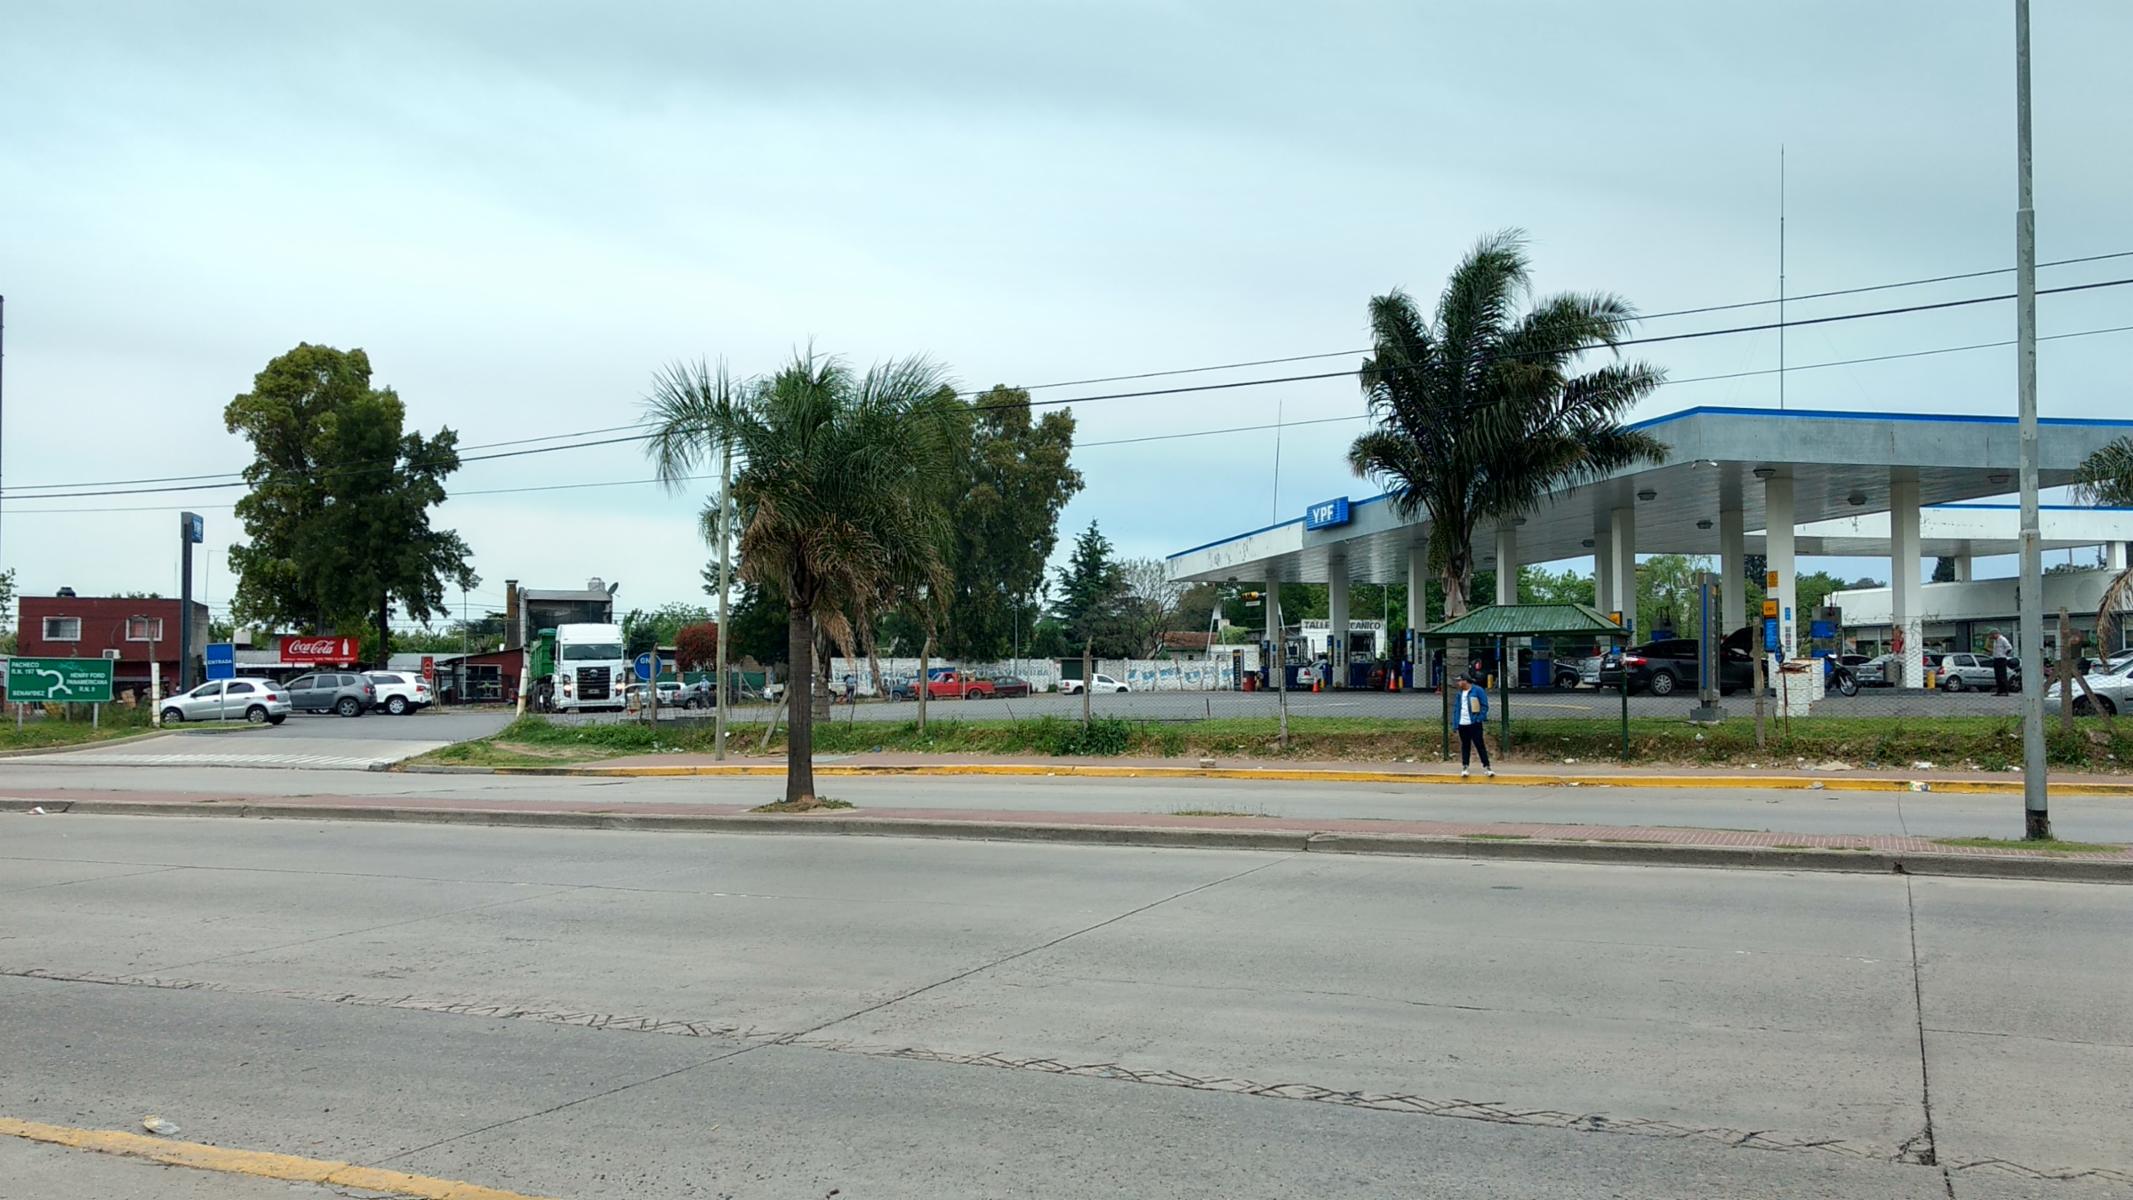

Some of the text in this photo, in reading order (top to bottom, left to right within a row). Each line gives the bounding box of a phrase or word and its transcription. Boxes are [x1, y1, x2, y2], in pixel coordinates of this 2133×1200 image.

[1312, 504, 1334, 524] YPF
[1304, 621, 1330, 629] TALLE
[288, 640, 336, 655] Coca-Cola
